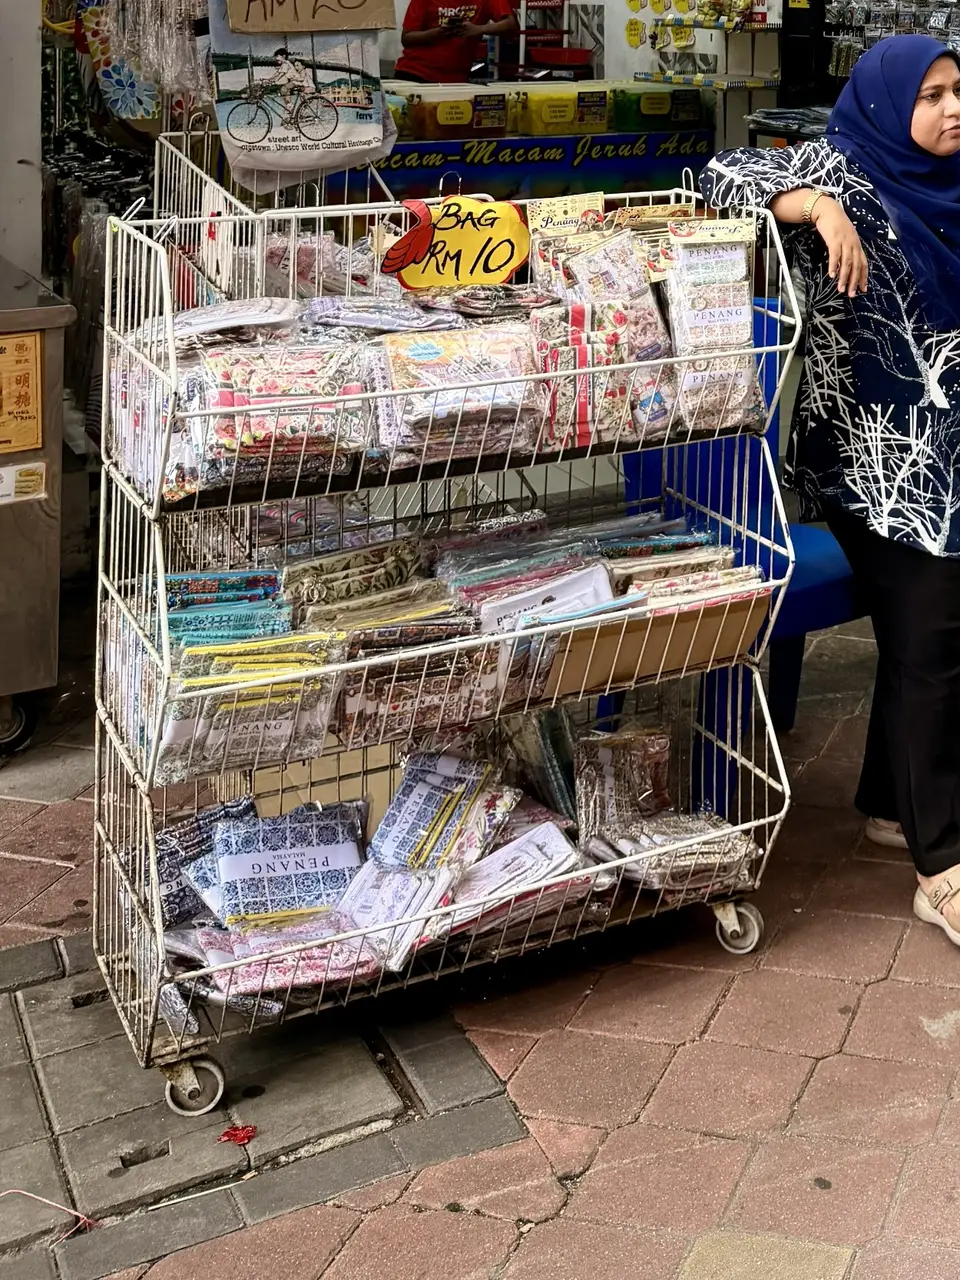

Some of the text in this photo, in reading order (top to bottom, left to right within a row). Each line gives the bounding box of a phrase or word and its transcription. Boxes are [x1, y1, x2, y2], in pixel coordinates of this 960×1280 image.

[300, 143, 321, 151] World
[321, 141, 347, 151] Cultural
[348, 138, 373, 148] Heritage
[356, 133, 709, 170] acam-Macam Jeruk Ada
[433, 202, 502, 232] BAG
[688, 245, 738, 258] PENANG
[693, 308, 742, 321] PENANG
[692, 372, 743, 383] PENANG
[391, 792, 425, 844] PENANG
[272, 850, 306, 861] MALAYSIA
[251, 856, 330, 875] PENANG
